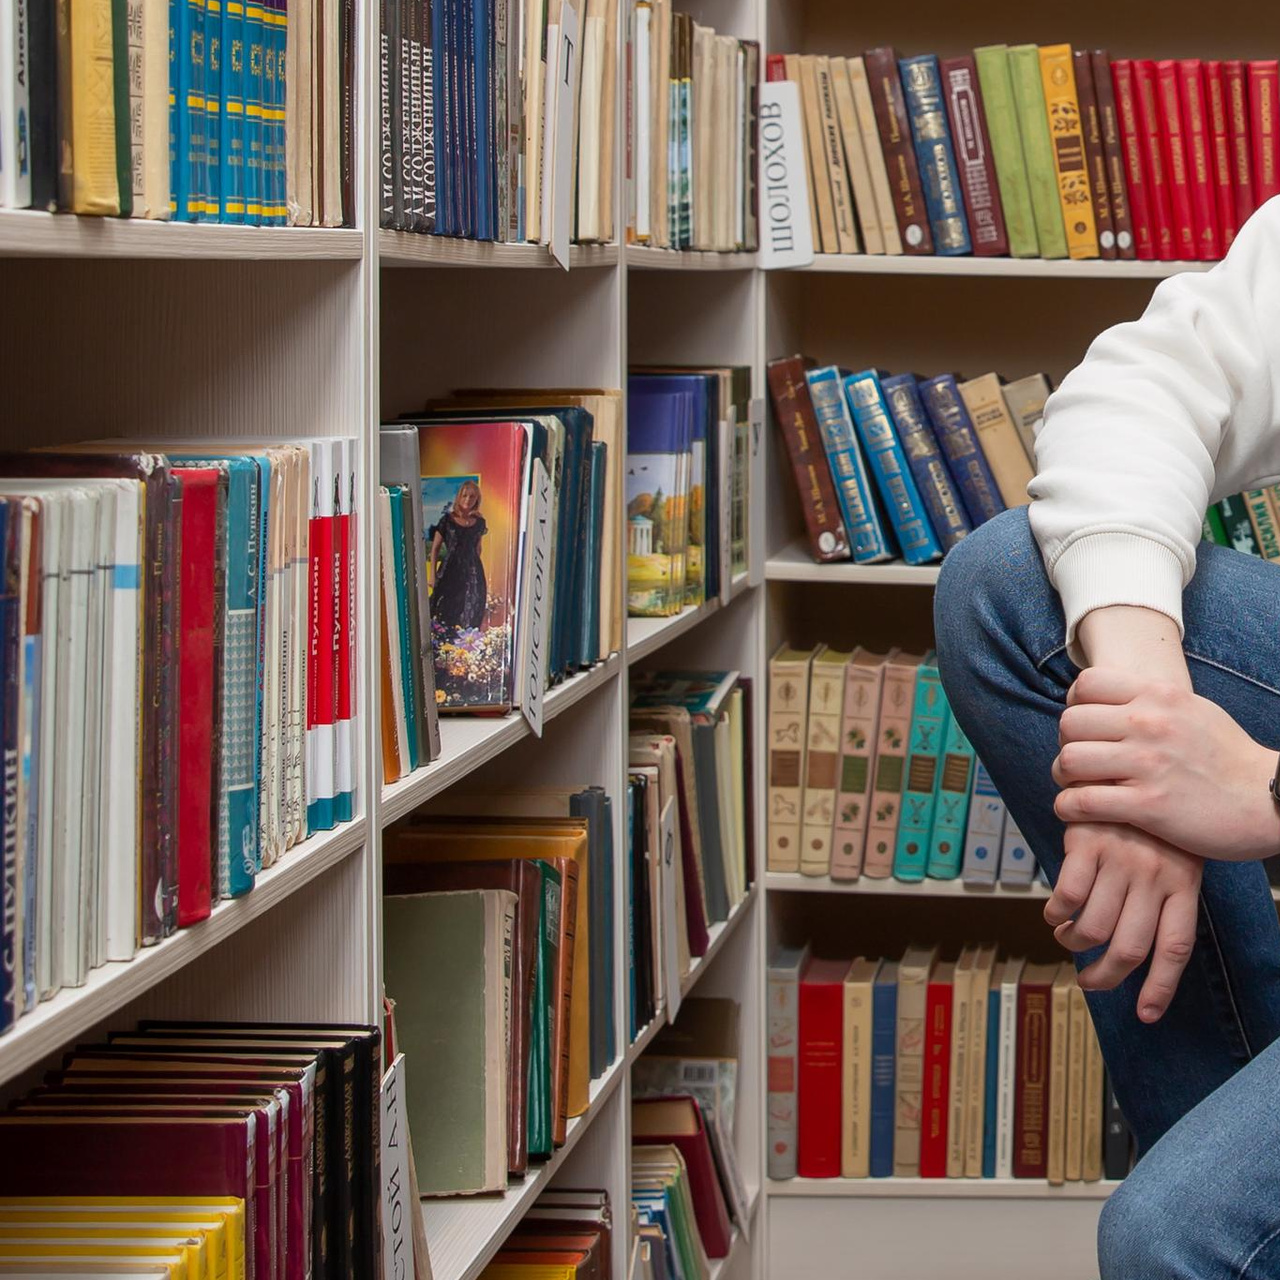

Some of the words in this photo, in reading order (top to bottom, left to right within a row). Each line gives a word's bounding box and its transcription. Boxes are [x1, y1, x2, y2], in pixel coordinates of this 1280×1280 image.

[381, 33, 393, 180] СОЛЖЕНИЦЫН
[410, 40, 424, 182] СОЛЖЕНИЦЫН
[423, 47, 437, 187] СОЛЖЕНИЦЫН
[563, 34, 573, 86] Т
[758, 101, 794, 254] ШОЛОХОВ
[247, 483, 258, 553] Пушкин
[311, 556, 321, 656] Пушкин
[331, 552, 342, 651] Пушкин
[529, 546, 545, 721] ТОЛСТОЙ
[3, 749, 18, 932] ПУШКИН
